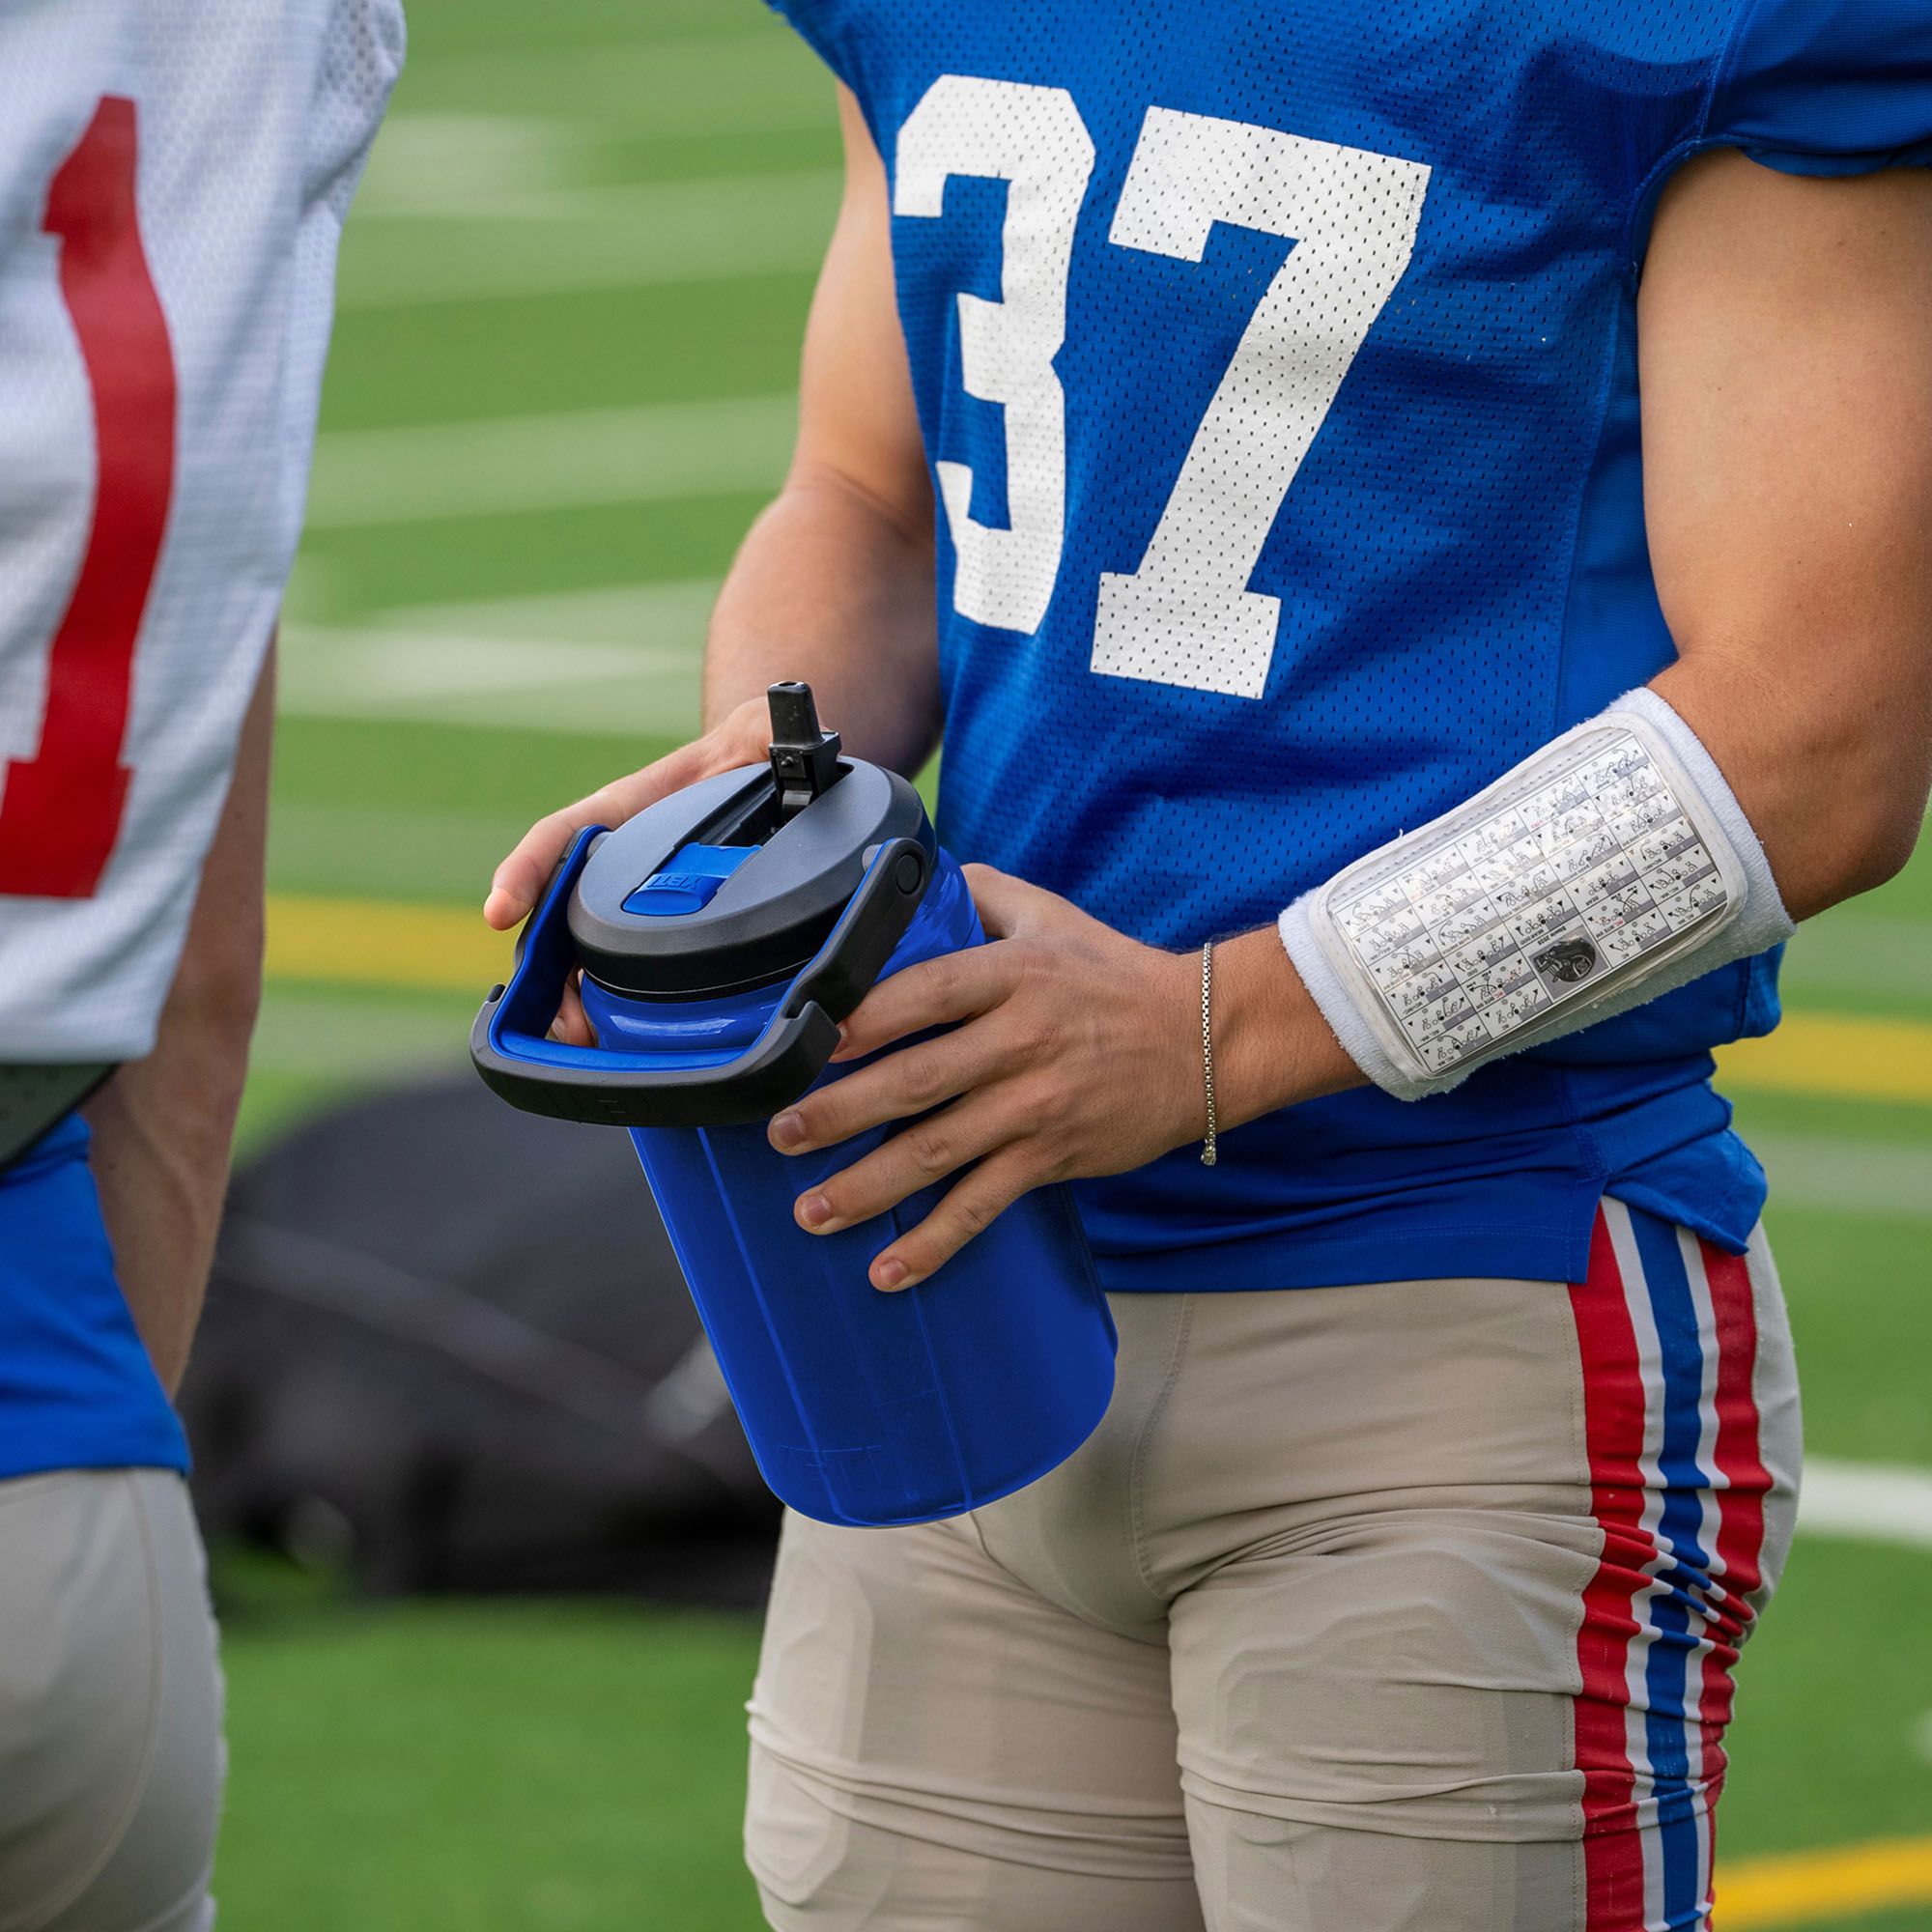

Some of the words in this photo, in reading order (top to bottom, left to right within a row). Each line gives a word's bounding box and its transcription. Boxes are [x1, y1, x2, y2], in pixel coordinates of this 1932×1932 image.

[0, 94, 180, 900] 1
[894, 73, 1433, 700] 37
[646, 874, 701, 890] YETI
